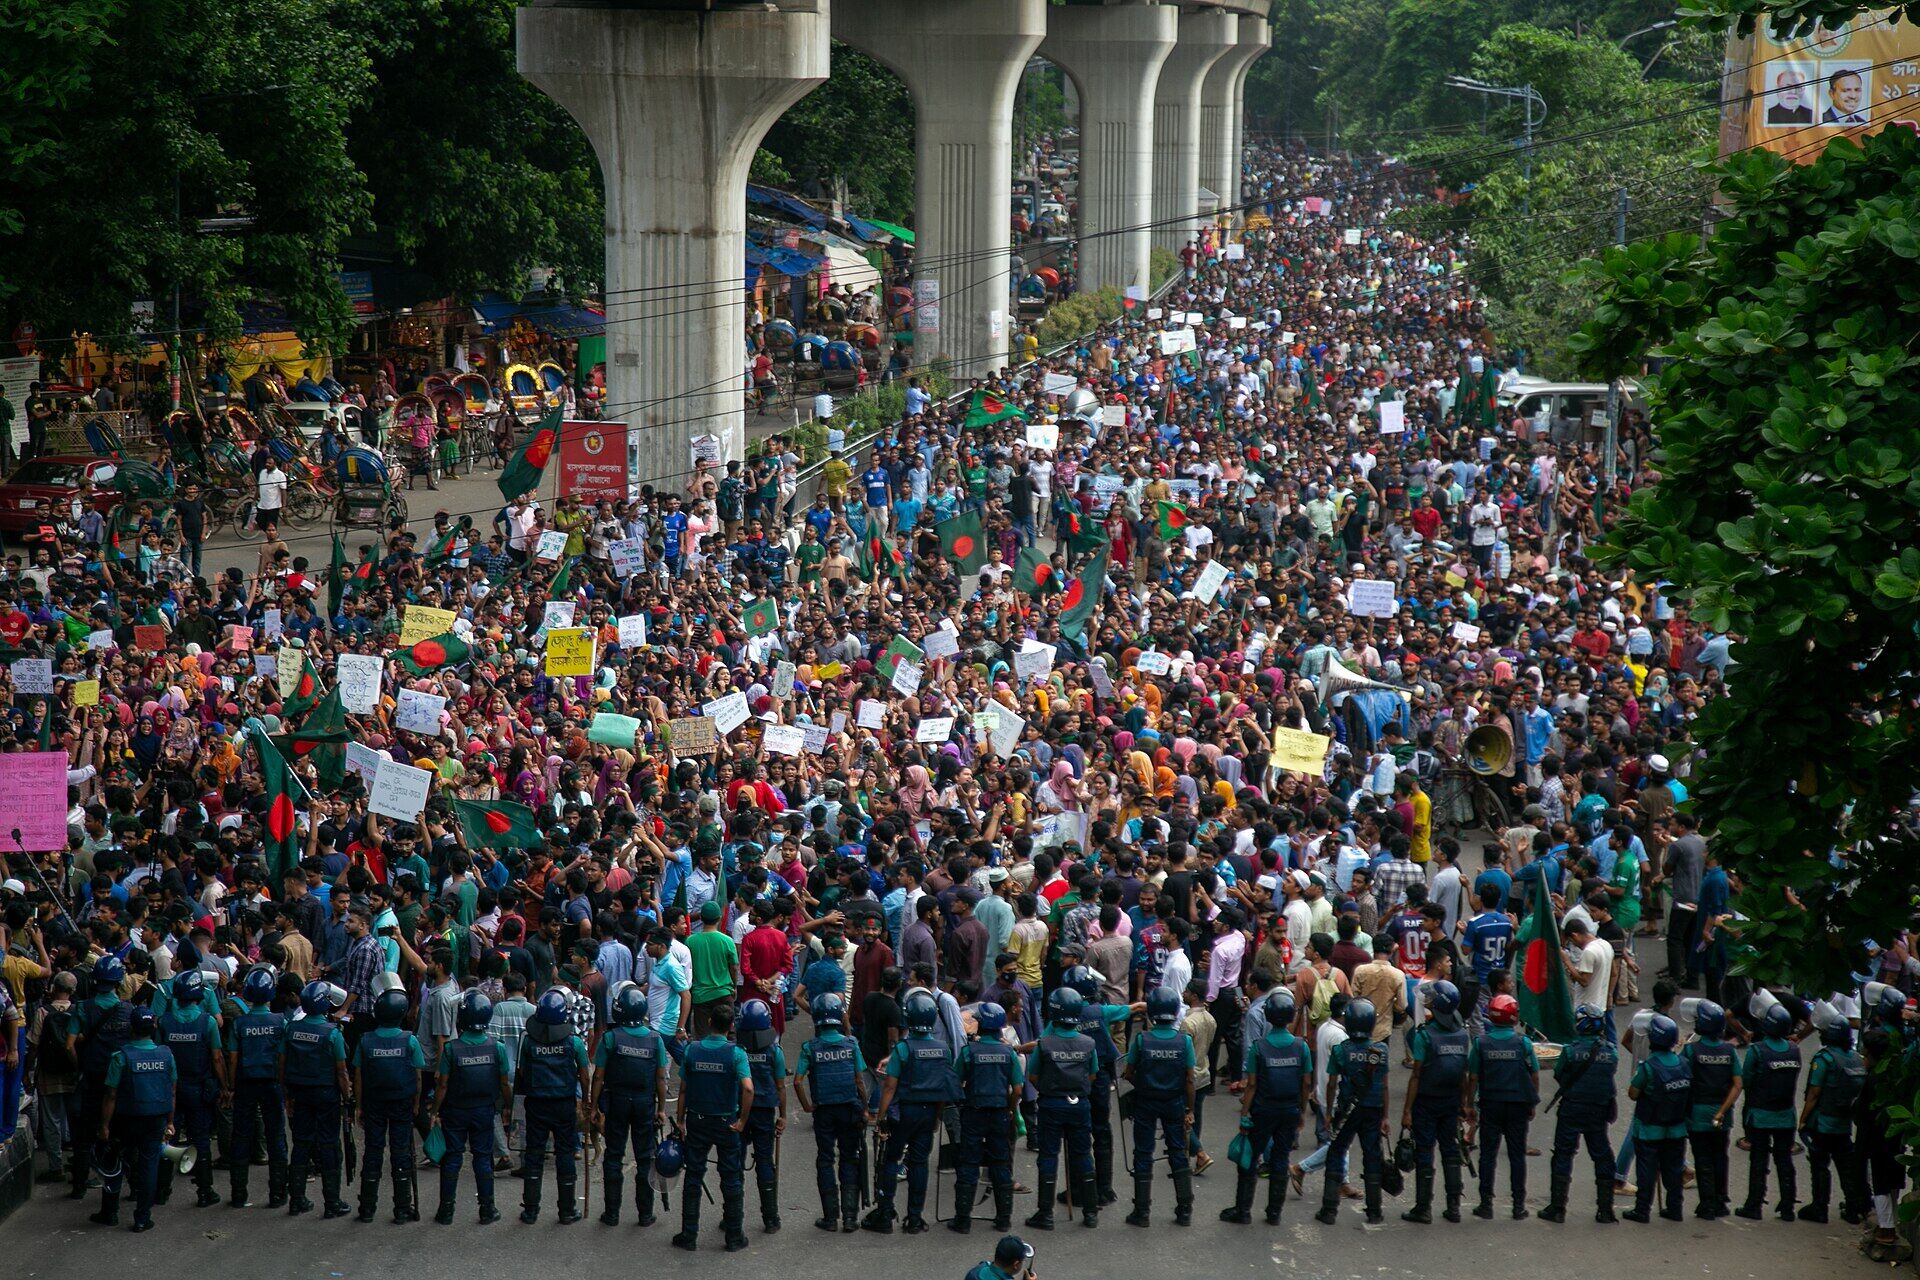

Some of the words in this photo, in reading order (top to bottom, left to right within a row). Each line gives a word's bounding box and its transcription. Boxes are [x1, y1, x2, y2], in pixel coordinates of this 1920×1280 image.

[566, 463, 597, 472] হাসপাতাল
[597, 464, 622, 473] এলাকায়
[588, 476, 610, 484] বাজানো
[1483, 936, 1507, 962] 50
[246, 1026, 275, 1036] POLICE
[1074, 1021, 1099, 1032] OLICE
[536, 1046, 564, 1055] POLICE
[1051, 1051, 1086, 1060] POLICE
[1150, 1050, 1178, 1059] POLICE
[815, 1049, 853, 1063] POLICE
[1349, 1052, 1387, 1064] POLE
[1701, 1056, 1729, 1064] POLICE
[136, 1061, 164, 1071] POLICE
